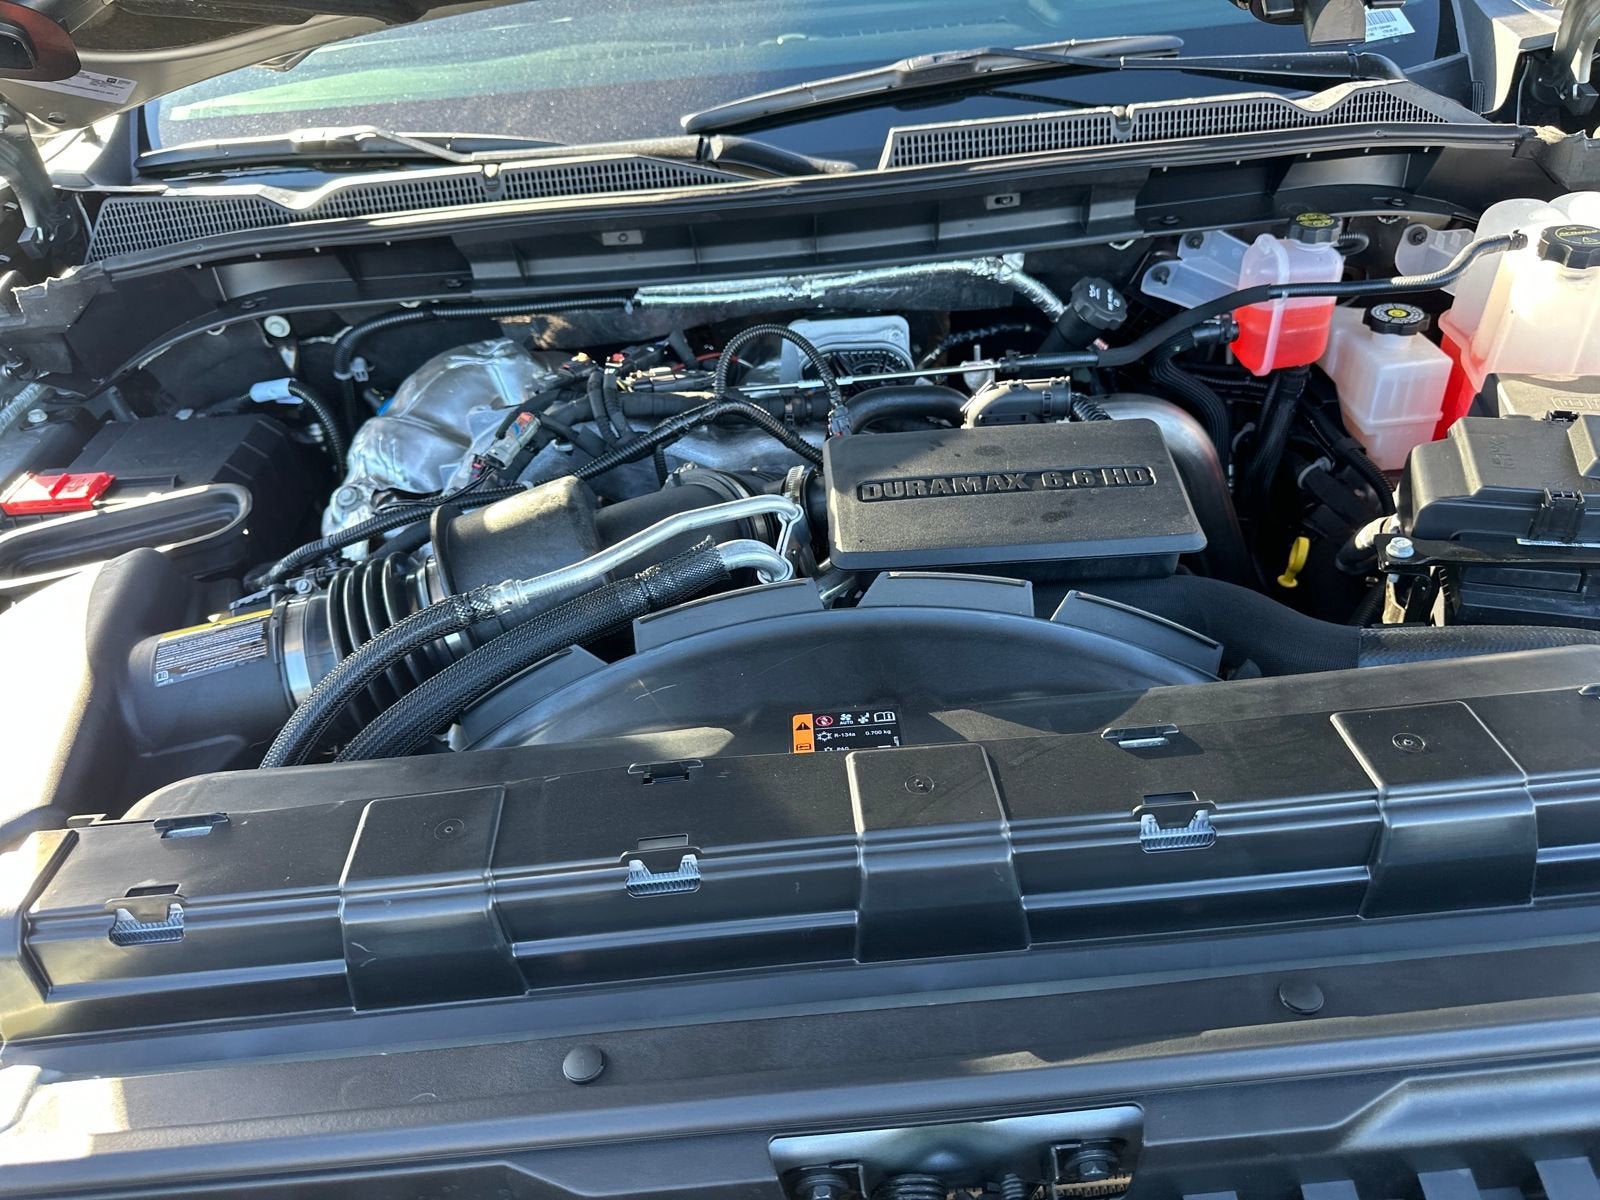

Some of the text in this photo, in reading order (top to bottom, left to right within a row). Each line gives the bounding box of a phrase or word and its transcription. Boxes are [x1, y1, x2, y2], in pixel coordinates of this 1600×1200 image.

[861, 466, 1153, 501] DURAMAX 6.6 HD
